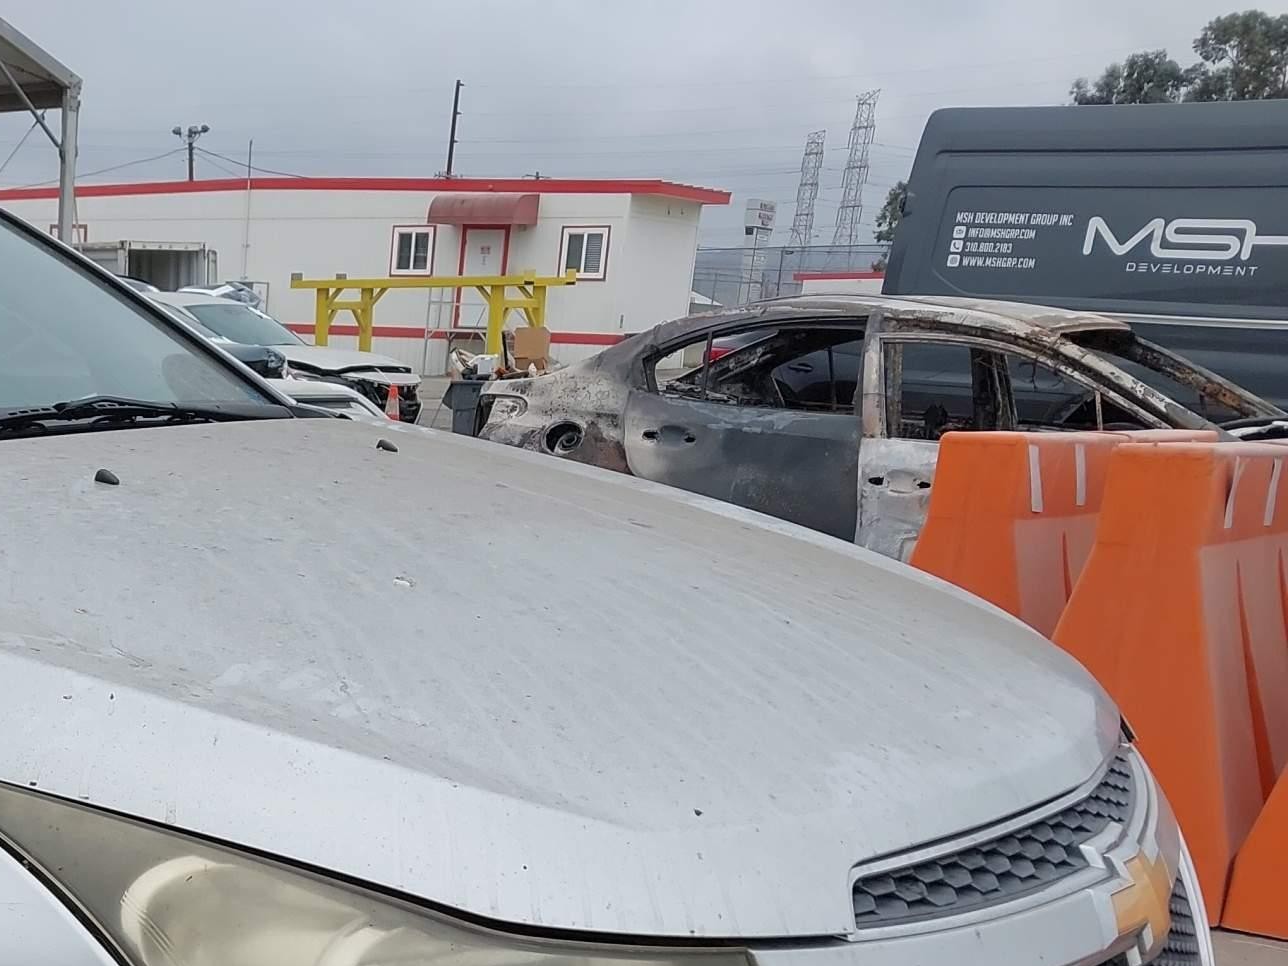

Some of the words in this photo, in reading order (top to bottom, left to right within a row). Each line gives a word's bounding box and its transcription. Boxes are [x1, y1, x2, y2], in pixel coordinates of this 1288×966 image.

[955, 212, 973, 223] MSH
[974, 212, 1030, 225] DEVELOPMENT
[1030, 213, 1059, 225] GROUP
[1059, 214, 1074, 226] INC
[967, 227, 1036, 240] INFO@MSHGRP.COM
[964, 241, 1012, 253] 310.800.2183
[962, 256, 1036, 269] WWW.MSHGRP.COM
[1125, 262, 1259, 276] DEVELOPMENT
